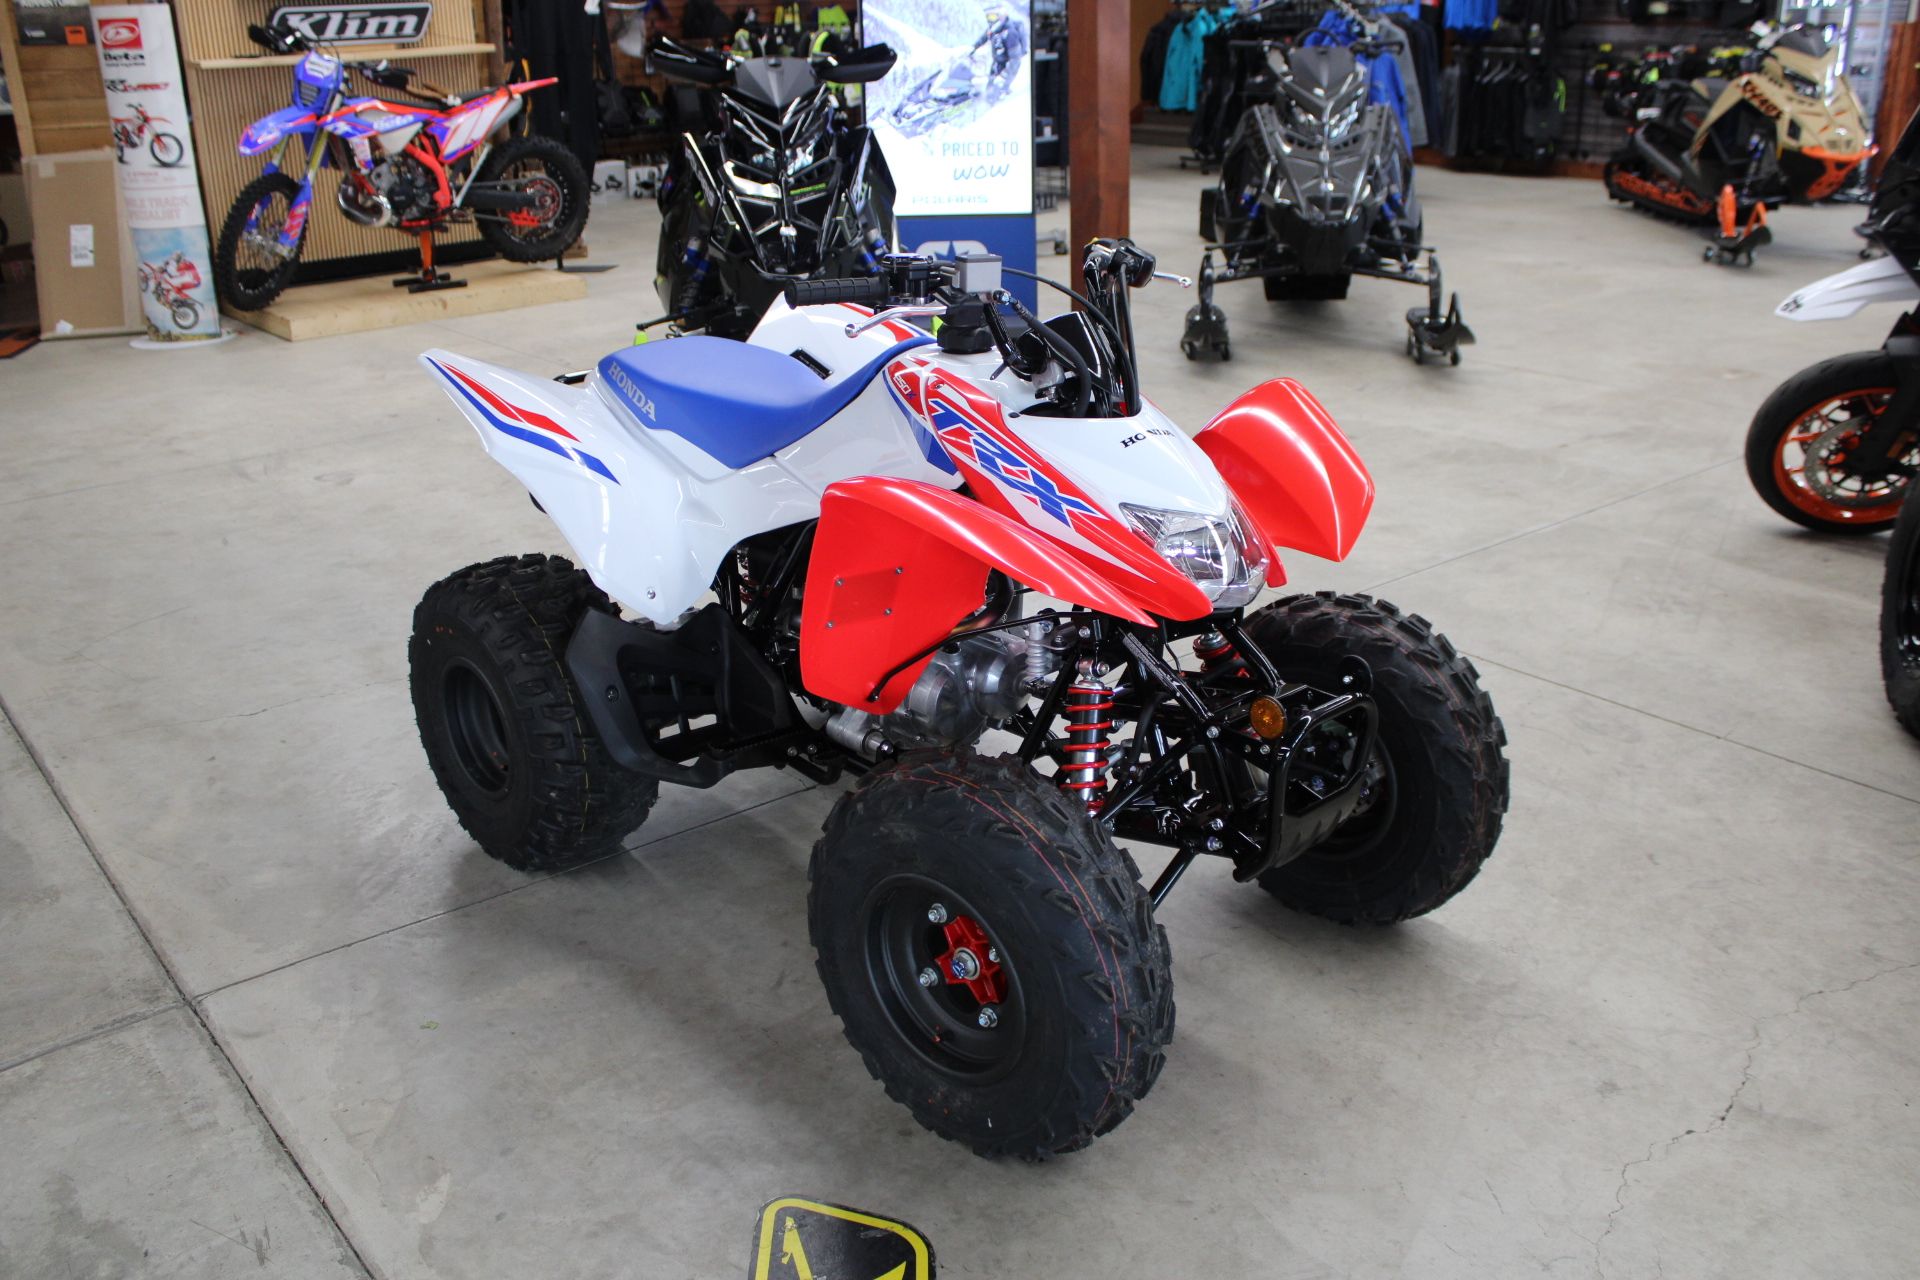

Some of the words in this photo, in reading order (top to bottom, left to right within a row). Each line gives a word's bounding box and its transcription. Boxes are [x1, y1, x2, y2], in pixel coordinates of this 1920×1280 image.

[103, 52, 145, 61] Beta
[942, 142, 995, 157] PRICED
[1002, 141, 1020, 156] TO
[952, 164, 1010, 181] WOW
[607, 360, 657, 422] HONDA
[928, 398, 1111, 529] TRX
